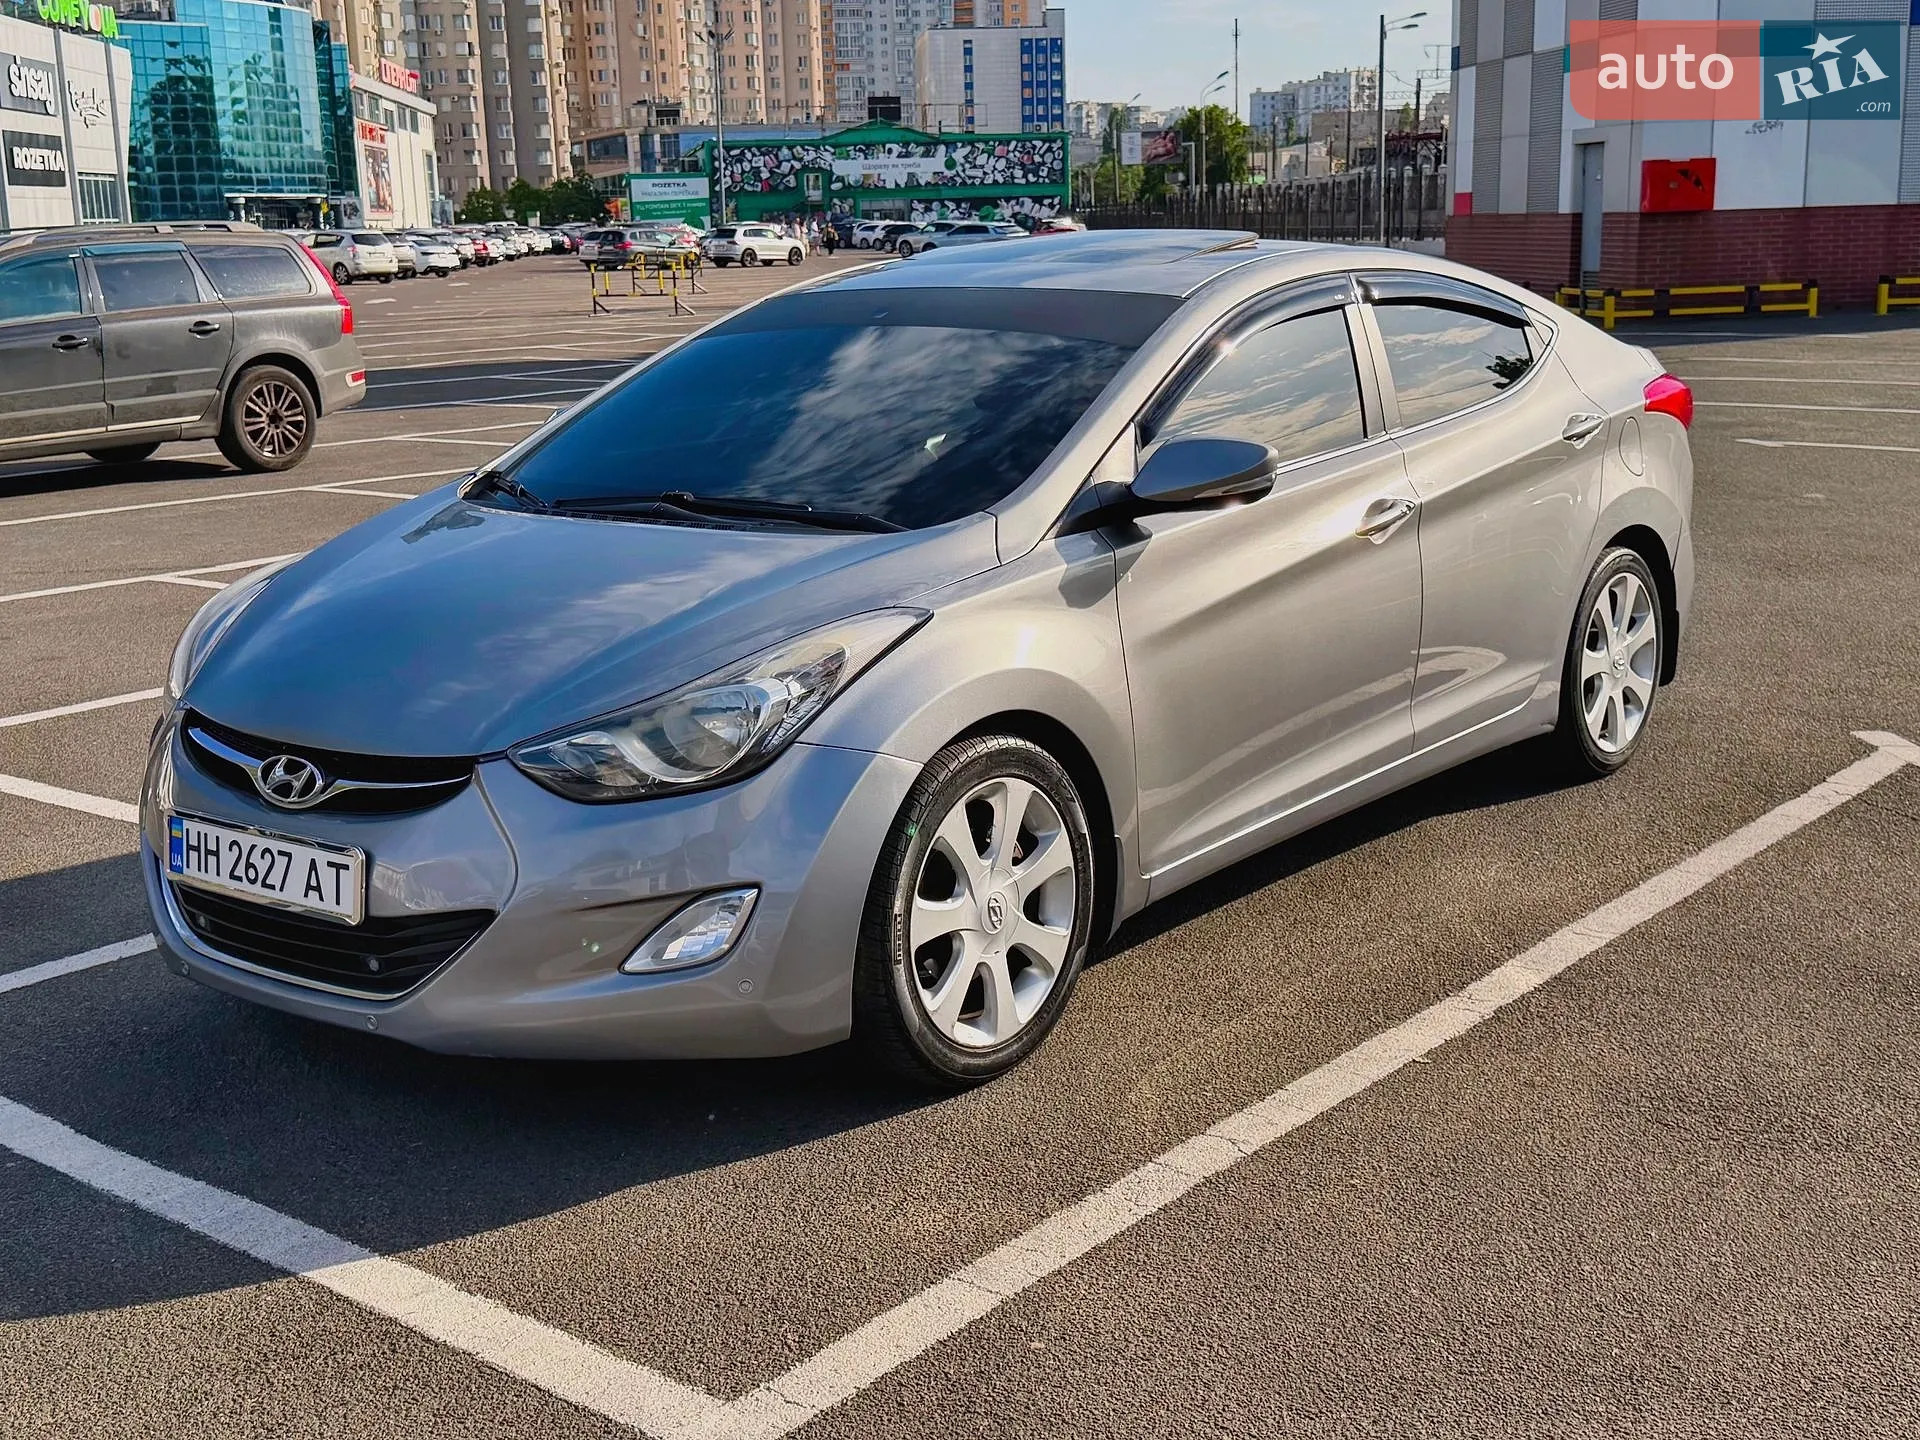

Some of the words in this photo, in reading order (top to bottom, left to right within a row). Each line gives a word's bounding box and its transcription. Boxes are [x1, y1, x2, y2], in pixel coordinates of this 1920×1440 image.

[12, 146, 65, 171] ROZETKA
[171, 853, 182, 867] UA
[186, 828, 220, 877] HH
[228, 839, 293, 892] 2627
[303, 857, 350, 905] AT
